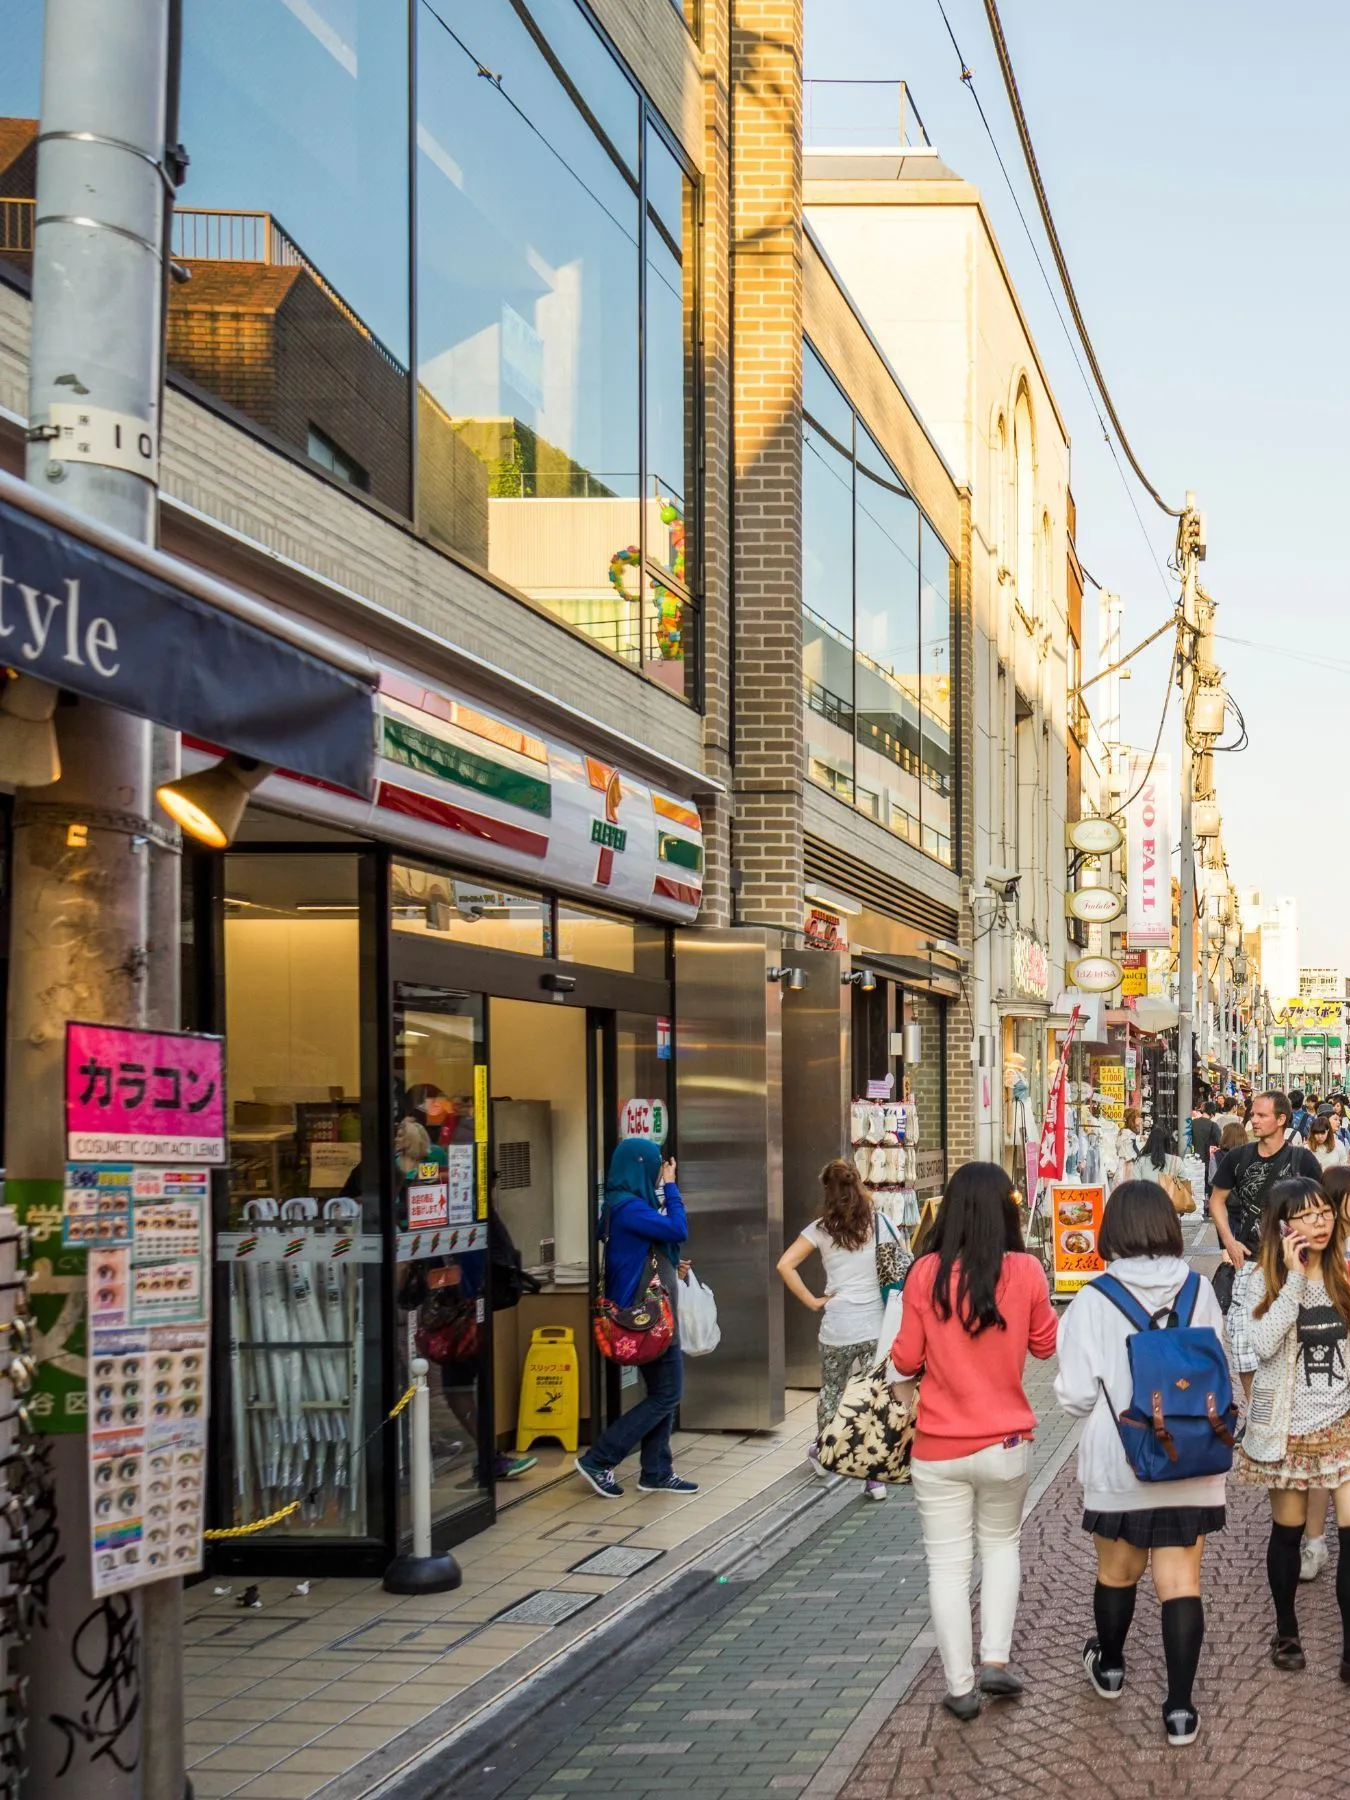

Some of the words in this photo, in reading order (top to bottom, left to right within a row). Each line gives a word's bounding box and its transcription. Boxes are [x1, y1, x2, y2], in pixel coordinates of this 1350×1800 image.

[1141, 782, 1156, 828] NO
[1141, 837, 1156, 913] FALL
[79, 1056, 216, 1113] カラコン
[627, 1106, 650, 1134] たばこ
